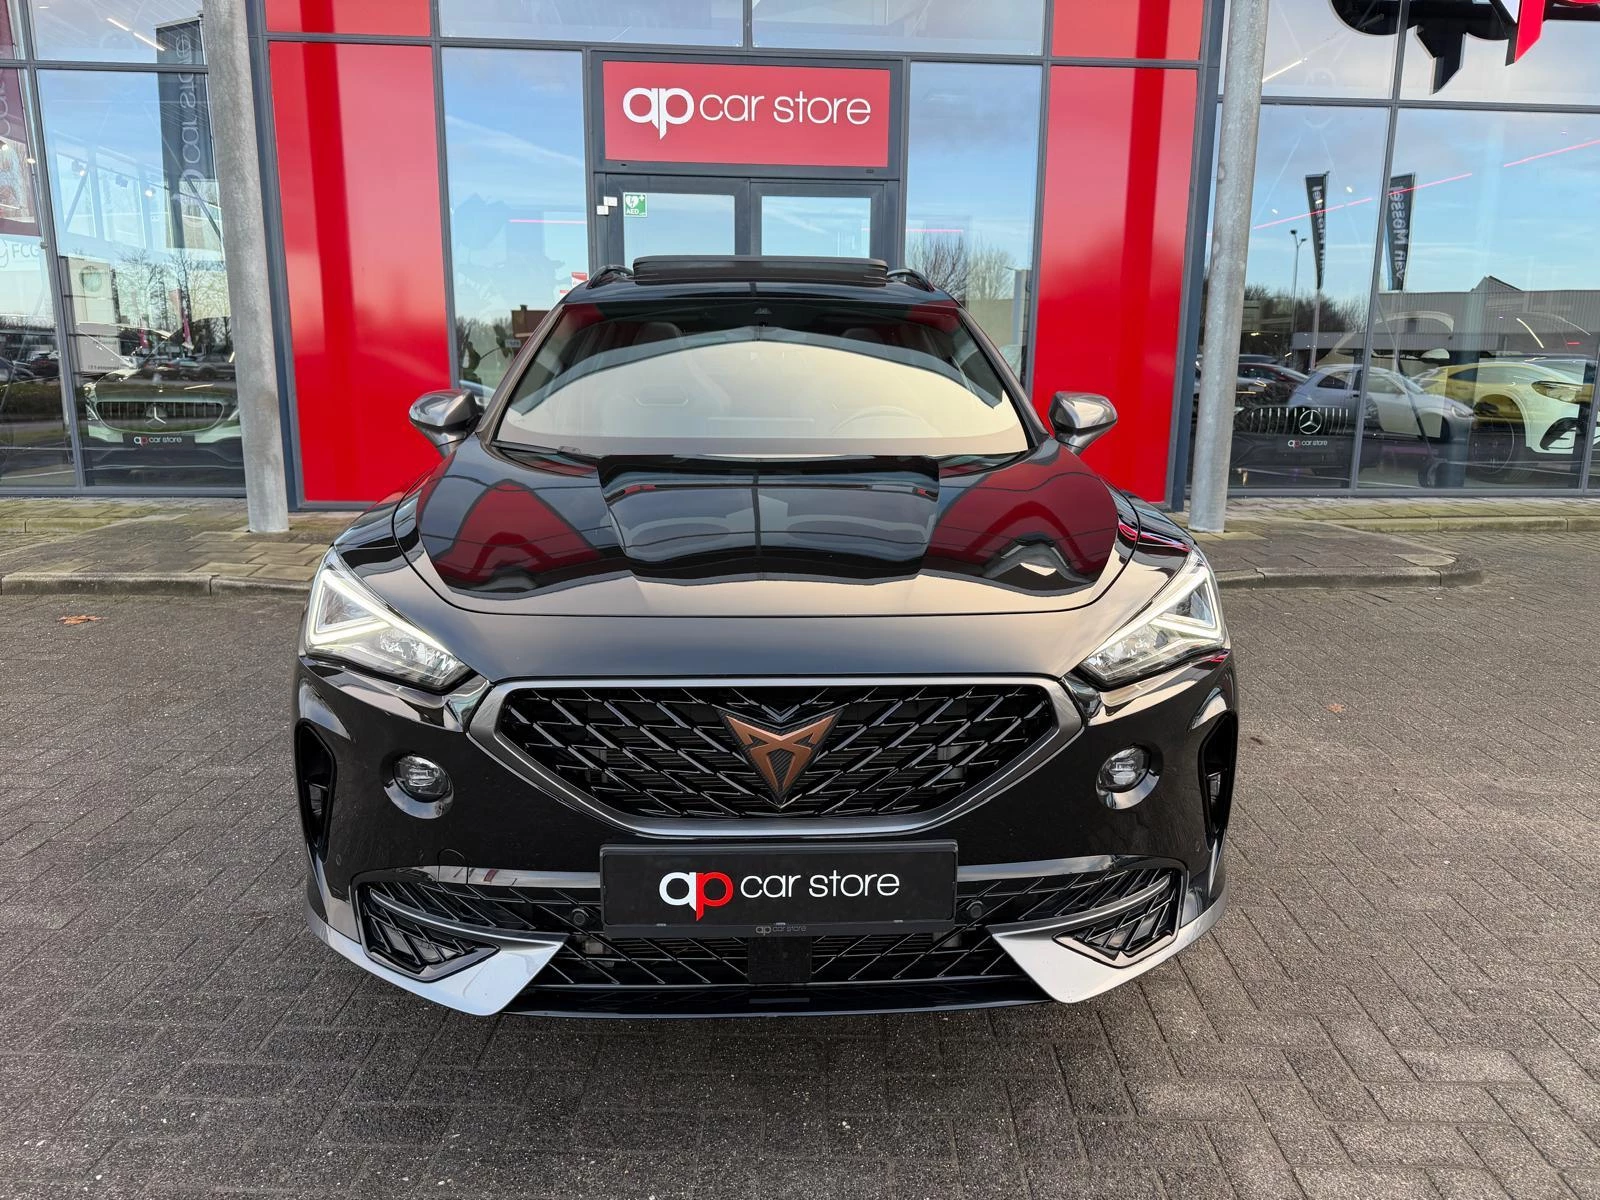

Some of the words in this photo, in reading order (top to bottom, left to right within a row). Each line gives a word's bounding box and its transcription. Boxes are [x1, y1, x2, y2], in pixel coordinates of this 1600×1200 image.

[622, 87, 695, 140] ap
[700, 94, 764, 122] car
[773, 91, 872, 125] store
[658, 871, 734, 921] ap
[740, 875, 802, 899] car
[808, 870, 902, 898] store
